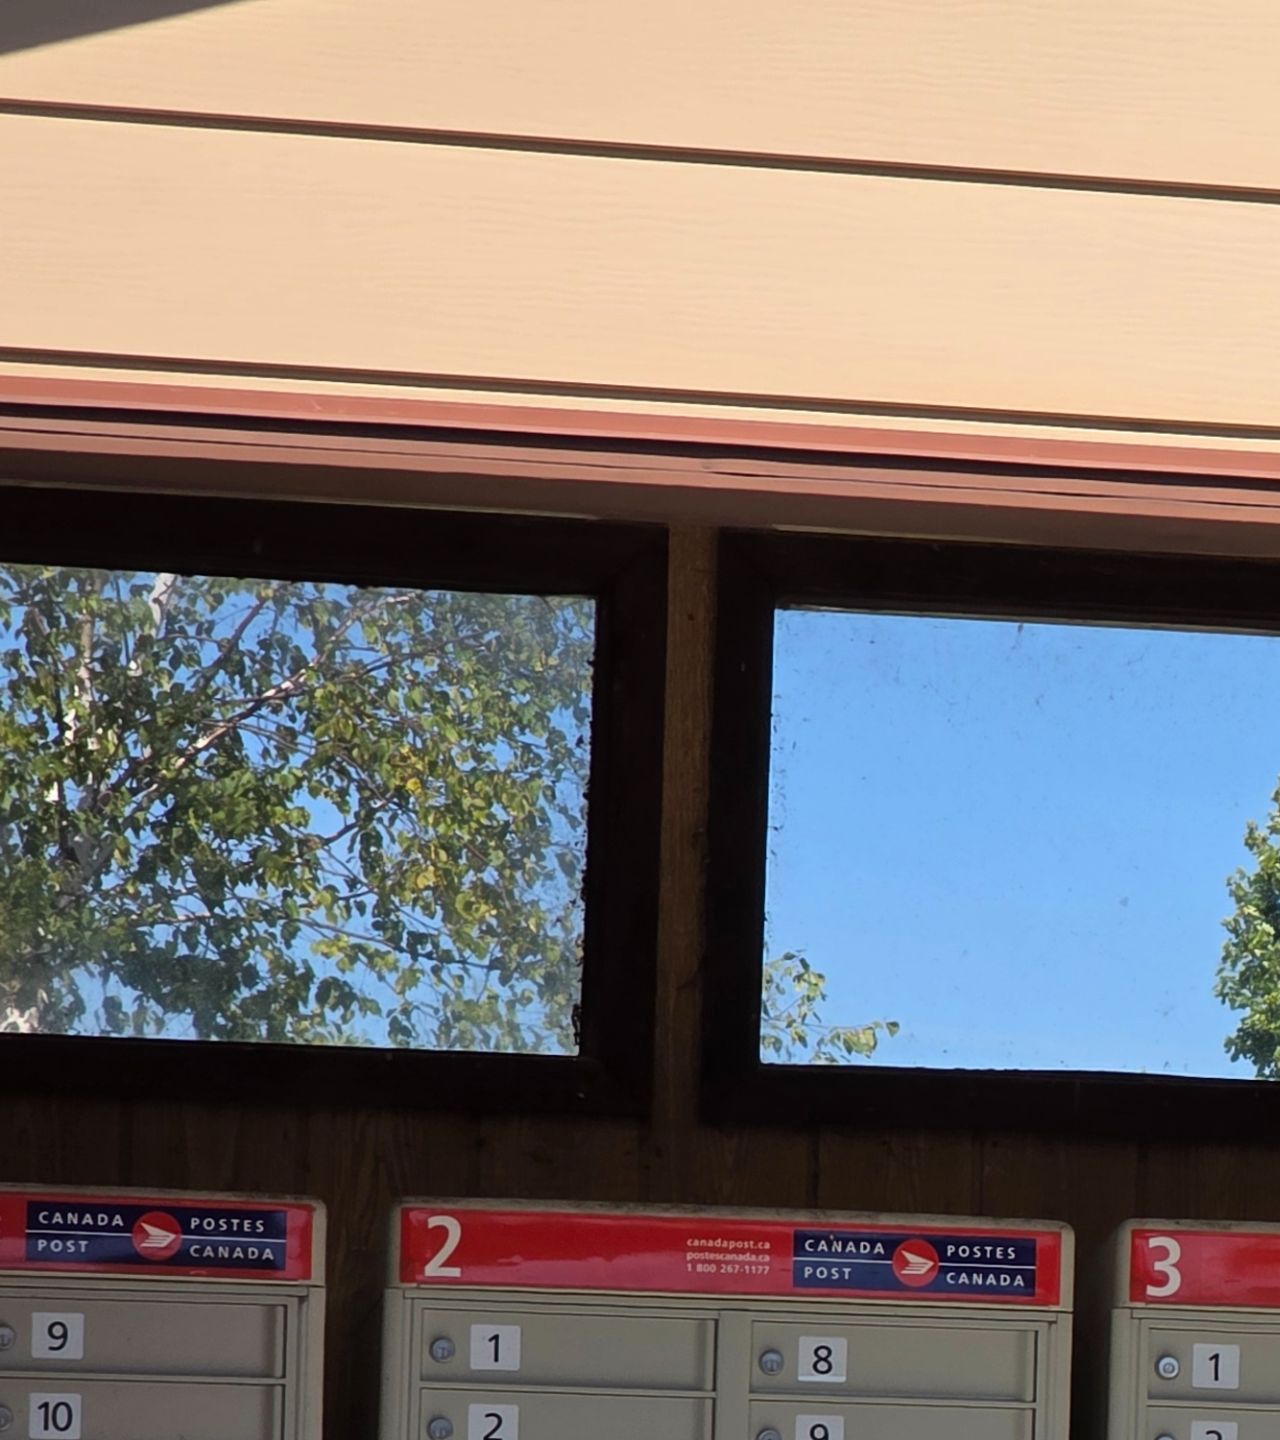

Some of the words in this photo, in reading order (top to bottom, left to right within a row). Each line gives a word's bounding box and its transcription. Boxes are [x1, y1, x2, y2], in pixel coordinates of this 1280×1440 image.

[38, 1211, 125, 1227] CANADA
[190, 1217, 266, 1233] POSTES
[37, 1240, 90, 1254] POST
[424, 1214, 462, 1278] 2
[686, 1237, 771, 1251] canadapost.ca
[804, 1239, 885, 1255] CANADA
[189, 1245, 275, 1261] CANADA
[946, 1245, 1017, 1260] POSTES
[696, 1264, 717, 1274] 800
[720, 1264, 770, 1275] 267-1177
[804, 1267, 852, 1280] POST
[1145, 1235, 1182, 1298] 3
[946, 1272, 1026, 1288] CANADA
[47, 1320, 69, 1352] 9
[487, 1333, 500, 1363] 1
[812, 1345, 833, 1375] 8
[1208, 1352, 1220, 1382] 1
[37, 1401, 73, 1432] 10
